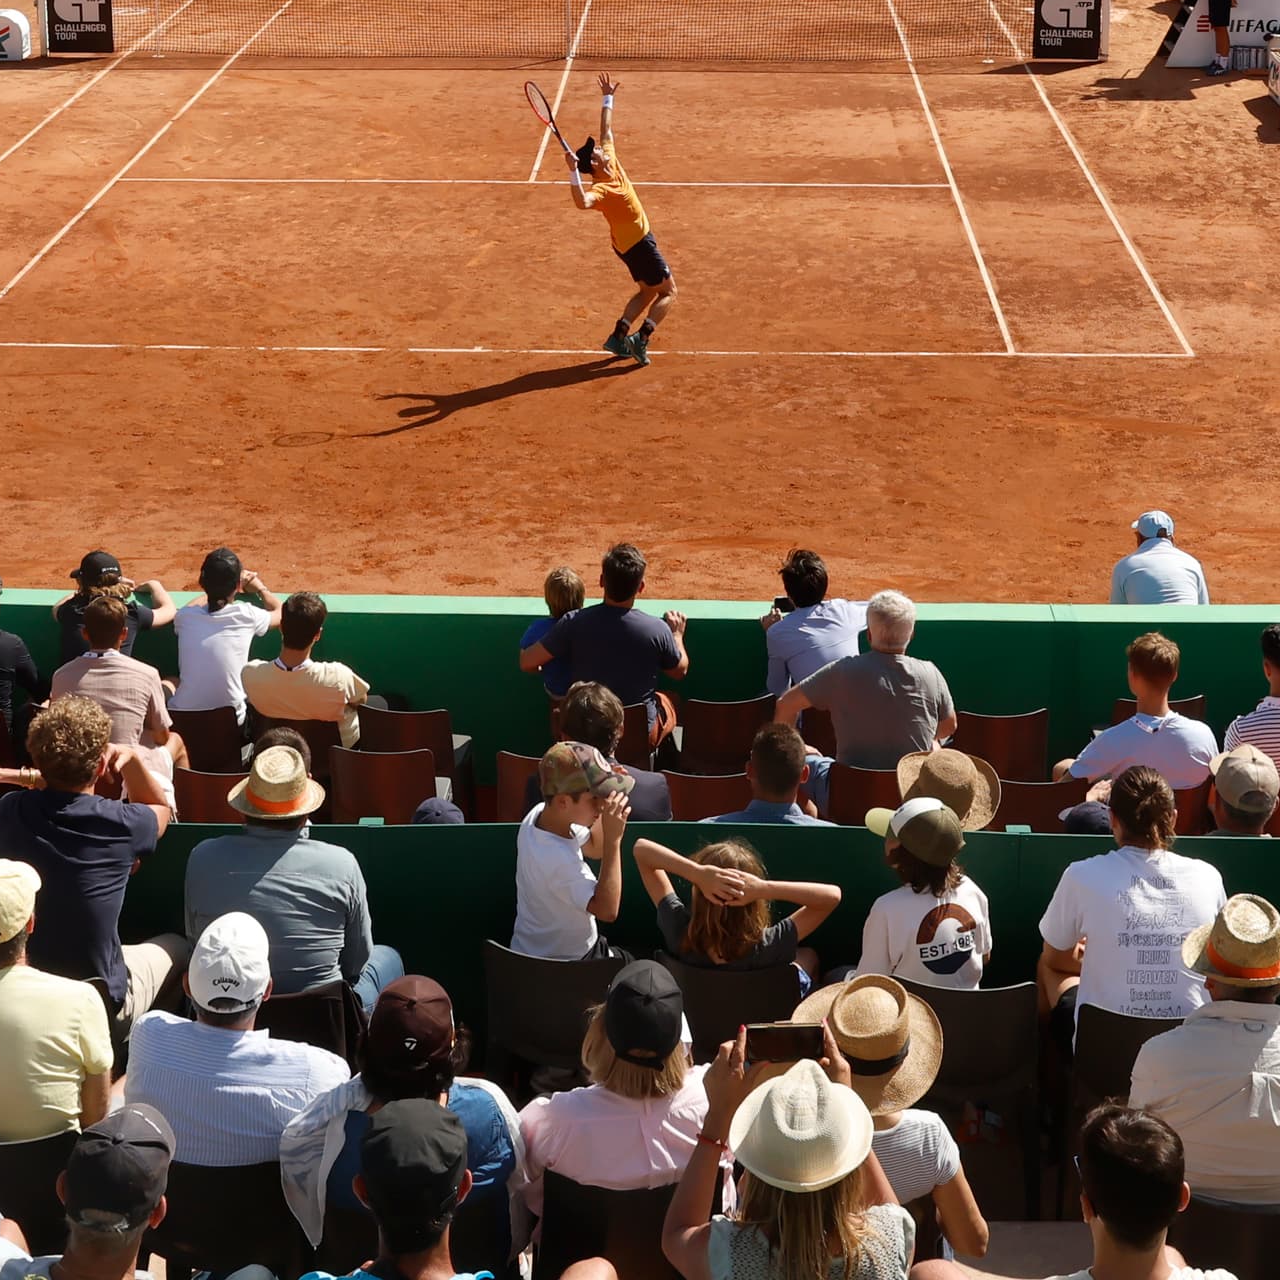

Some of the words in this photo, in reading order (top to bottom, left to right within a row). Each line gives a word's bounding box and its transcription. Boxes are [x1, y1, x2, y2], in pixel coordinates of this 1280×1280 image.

[54, 23, 107, 33] CHALLENGER
[55, 32, 78, 41] TOUR
[1039, 28, 1094, 39] CHALLENGER
[1039, 38, 1063, 47] TOUR
[920, 943, 950, 959] EST.
[1127, 970, 1178, 985] HEAVEN
